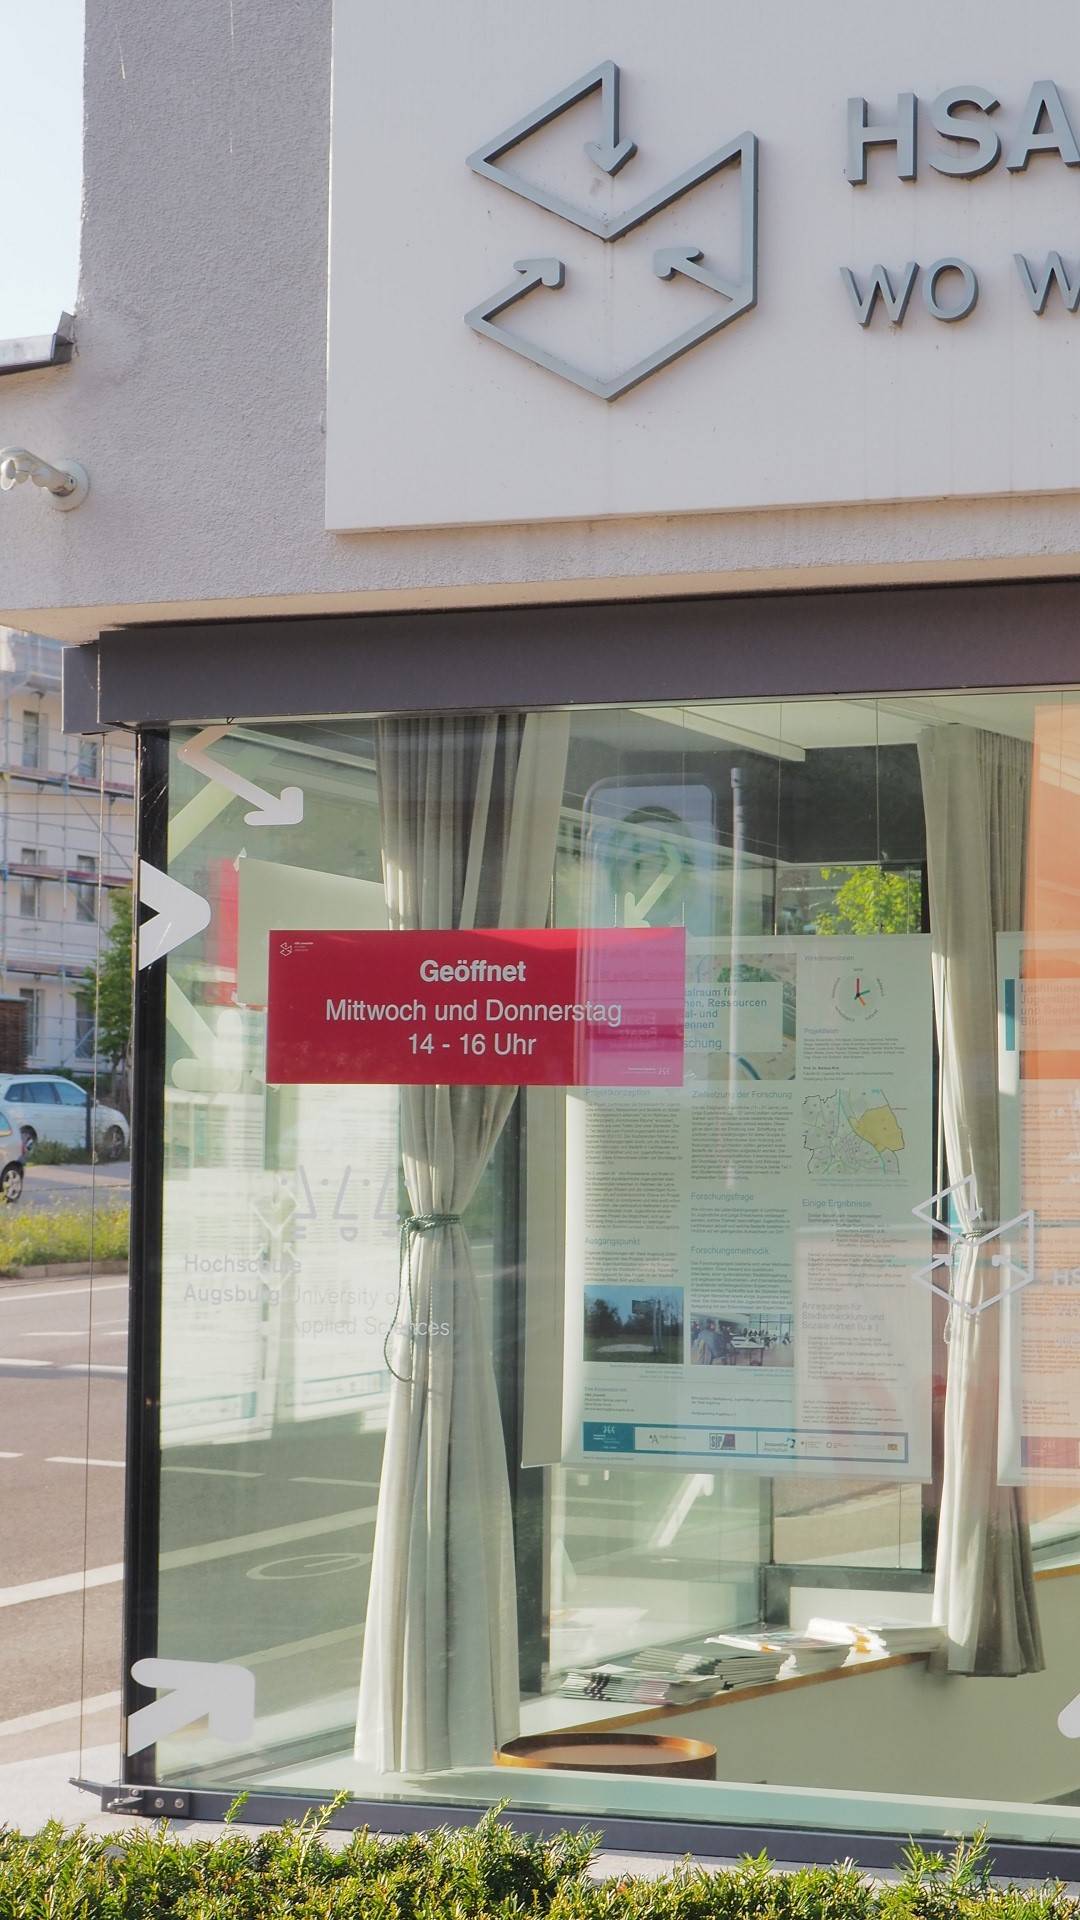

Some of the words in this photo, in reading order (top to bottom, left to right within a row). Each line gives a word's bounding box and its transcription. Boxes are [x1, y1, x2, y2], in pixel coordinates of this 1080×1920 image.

[840, 256, 979, 327] WO
[419, 958, 527, 984] Geöffnet
[325, 999, 429, 1022] Mittwoch
[434, 999, 480, 1022] und
[485, 999, 622, 1028] Donnerstag
[699, 1009, 718, 1019] und
[708, 998, 767, 1008] Ressourcen
[407, 1034, 435, 1056] 14
[459, 1034, 487, 1056] 16
[494, 1033, 537, 1056] Uhr
[690, 1090, 735, 1099] Zielsetzun
[752, 1090, 793, 1100] Forschung
[184, 1284, 280, 1306] Augsbug
[364, 1316, 451, 1337] Scnces
